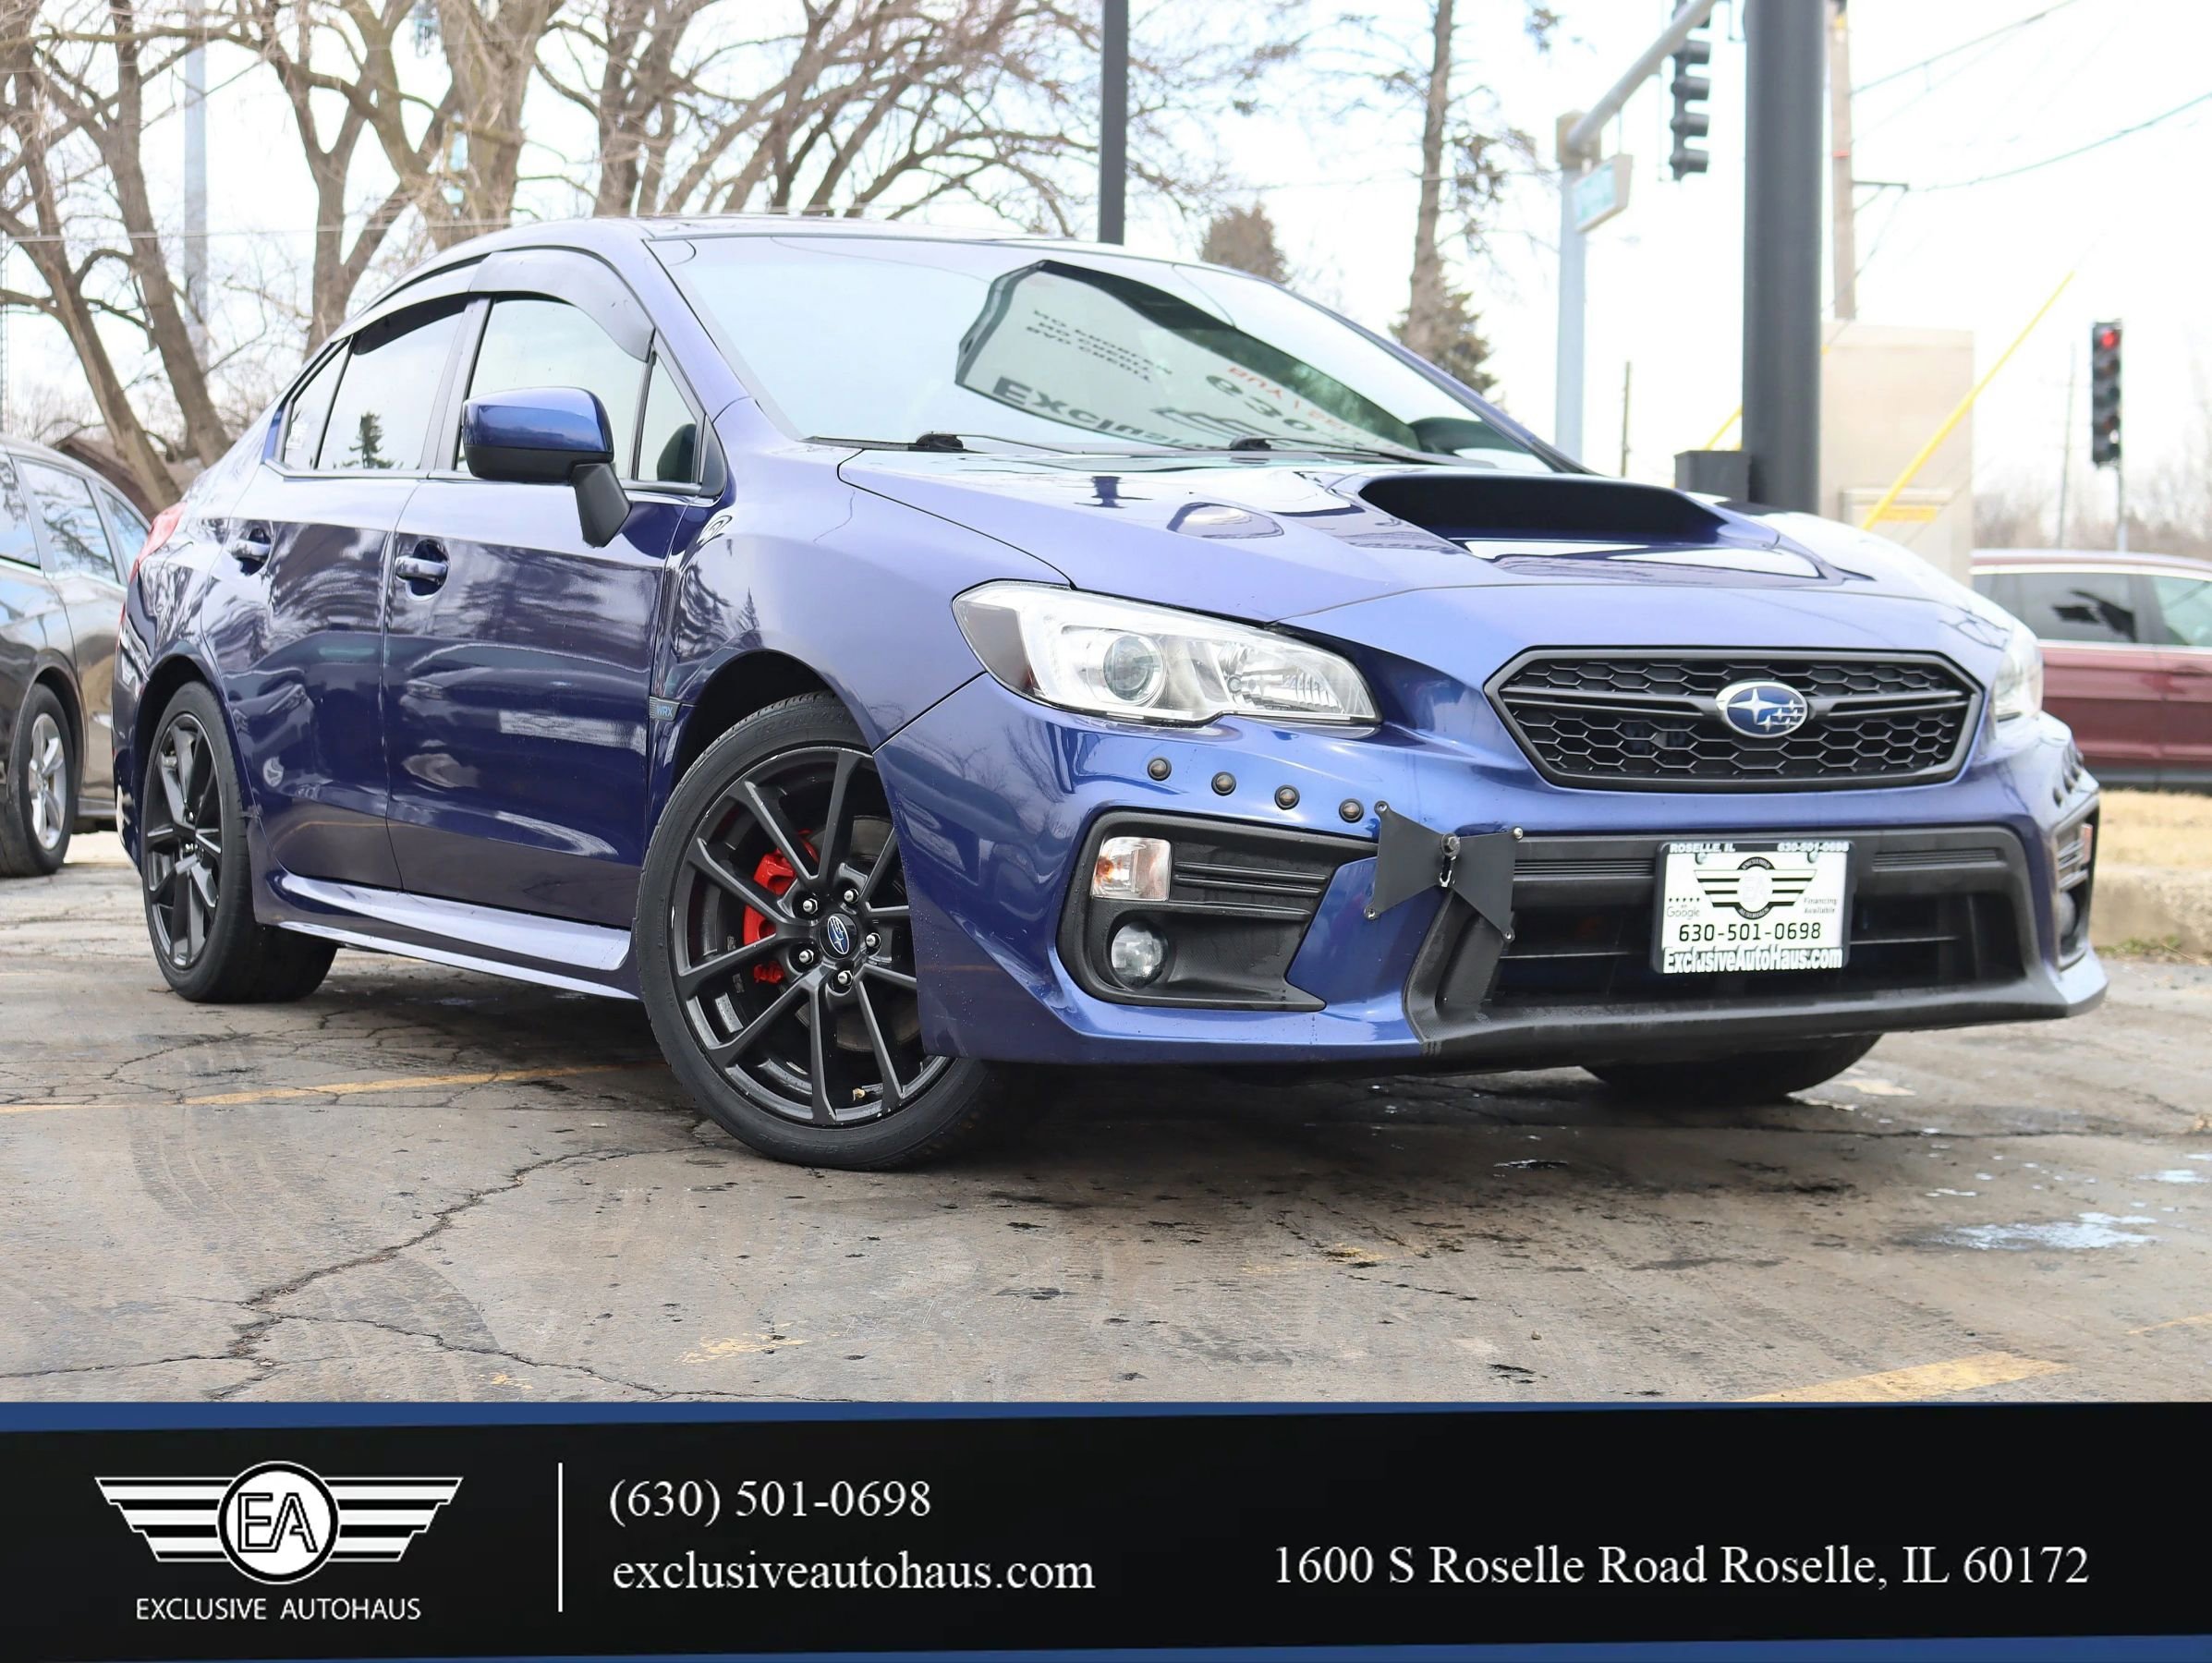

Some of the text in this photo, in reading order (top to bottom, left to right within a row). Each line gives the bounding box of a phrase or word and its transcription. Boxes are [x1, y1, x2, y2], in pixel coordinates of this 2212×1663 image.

[657, 704, 674, 718] WRX
[1723, 842, 1737, 854] IL
[1804, 896, 1838, 906] Financing
[1666, 905, 1701, 920] Google
[1678, 922, 1822, 942] 630-501-0698
[1663, 944, 1844, 974] ExclusiveAutoHaus.com
